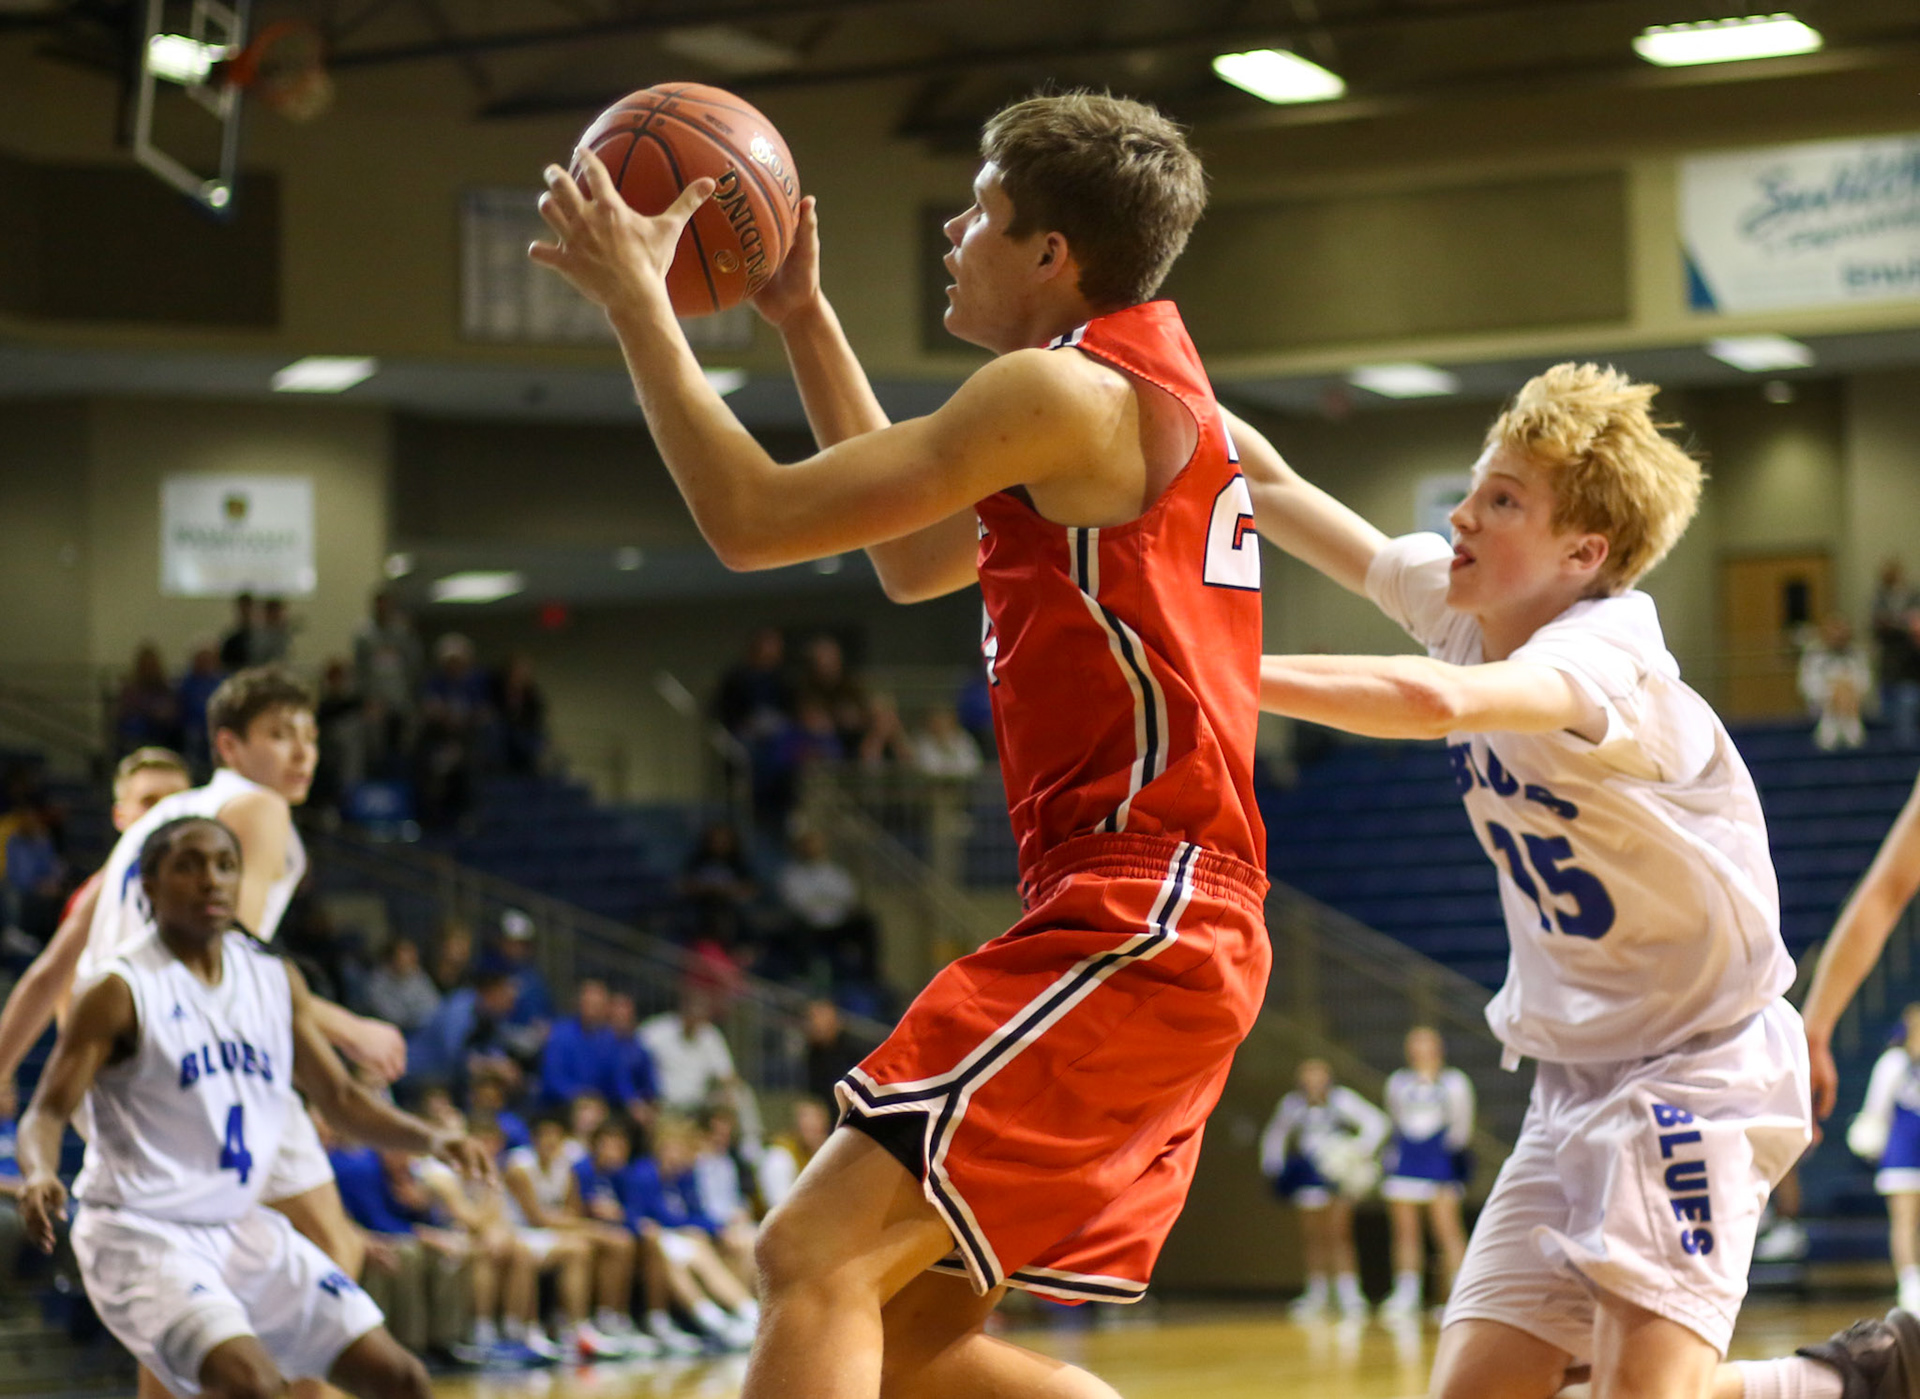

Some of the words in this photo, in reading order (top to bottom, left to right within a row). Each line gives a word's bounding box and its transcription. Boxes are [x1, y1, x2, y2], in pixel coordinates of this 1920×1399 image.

[1485, 820, 1616, 941] 15
[178, 1039, 274, 1090] BLUES
[219, 1104, 253, 1184] 4
[1651, 1103, 1714, 1256] BLUES
